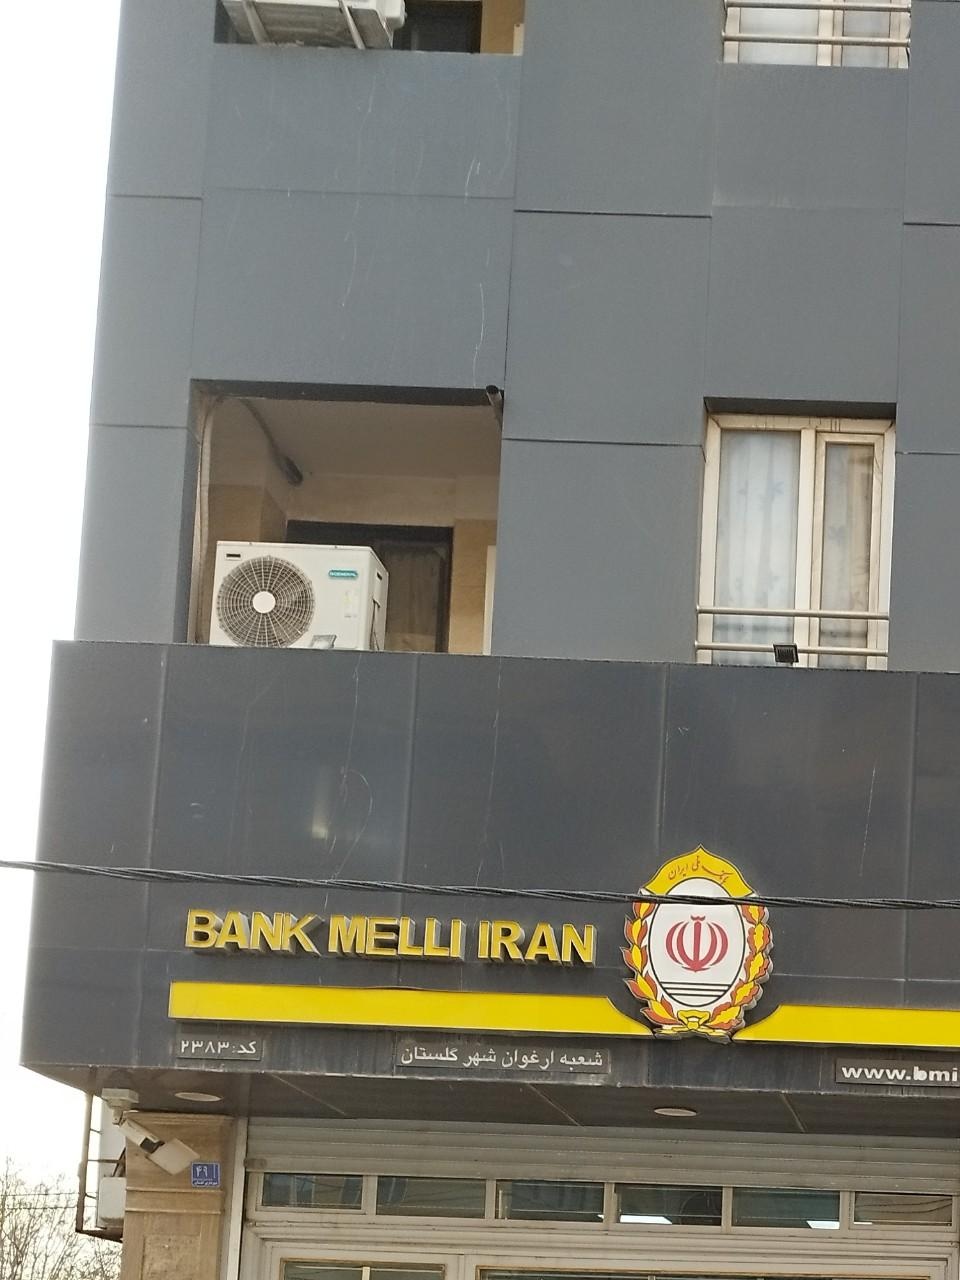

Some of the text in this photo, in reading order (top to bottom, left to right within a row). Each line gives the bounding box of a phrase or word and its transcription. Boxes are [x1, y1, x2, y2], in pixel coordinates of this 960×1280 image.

[185, 908, 596, 966] BANK MELLI IRAN
[400, 1046, 603, 1070] شعبه ارغوان شهر گلستان
